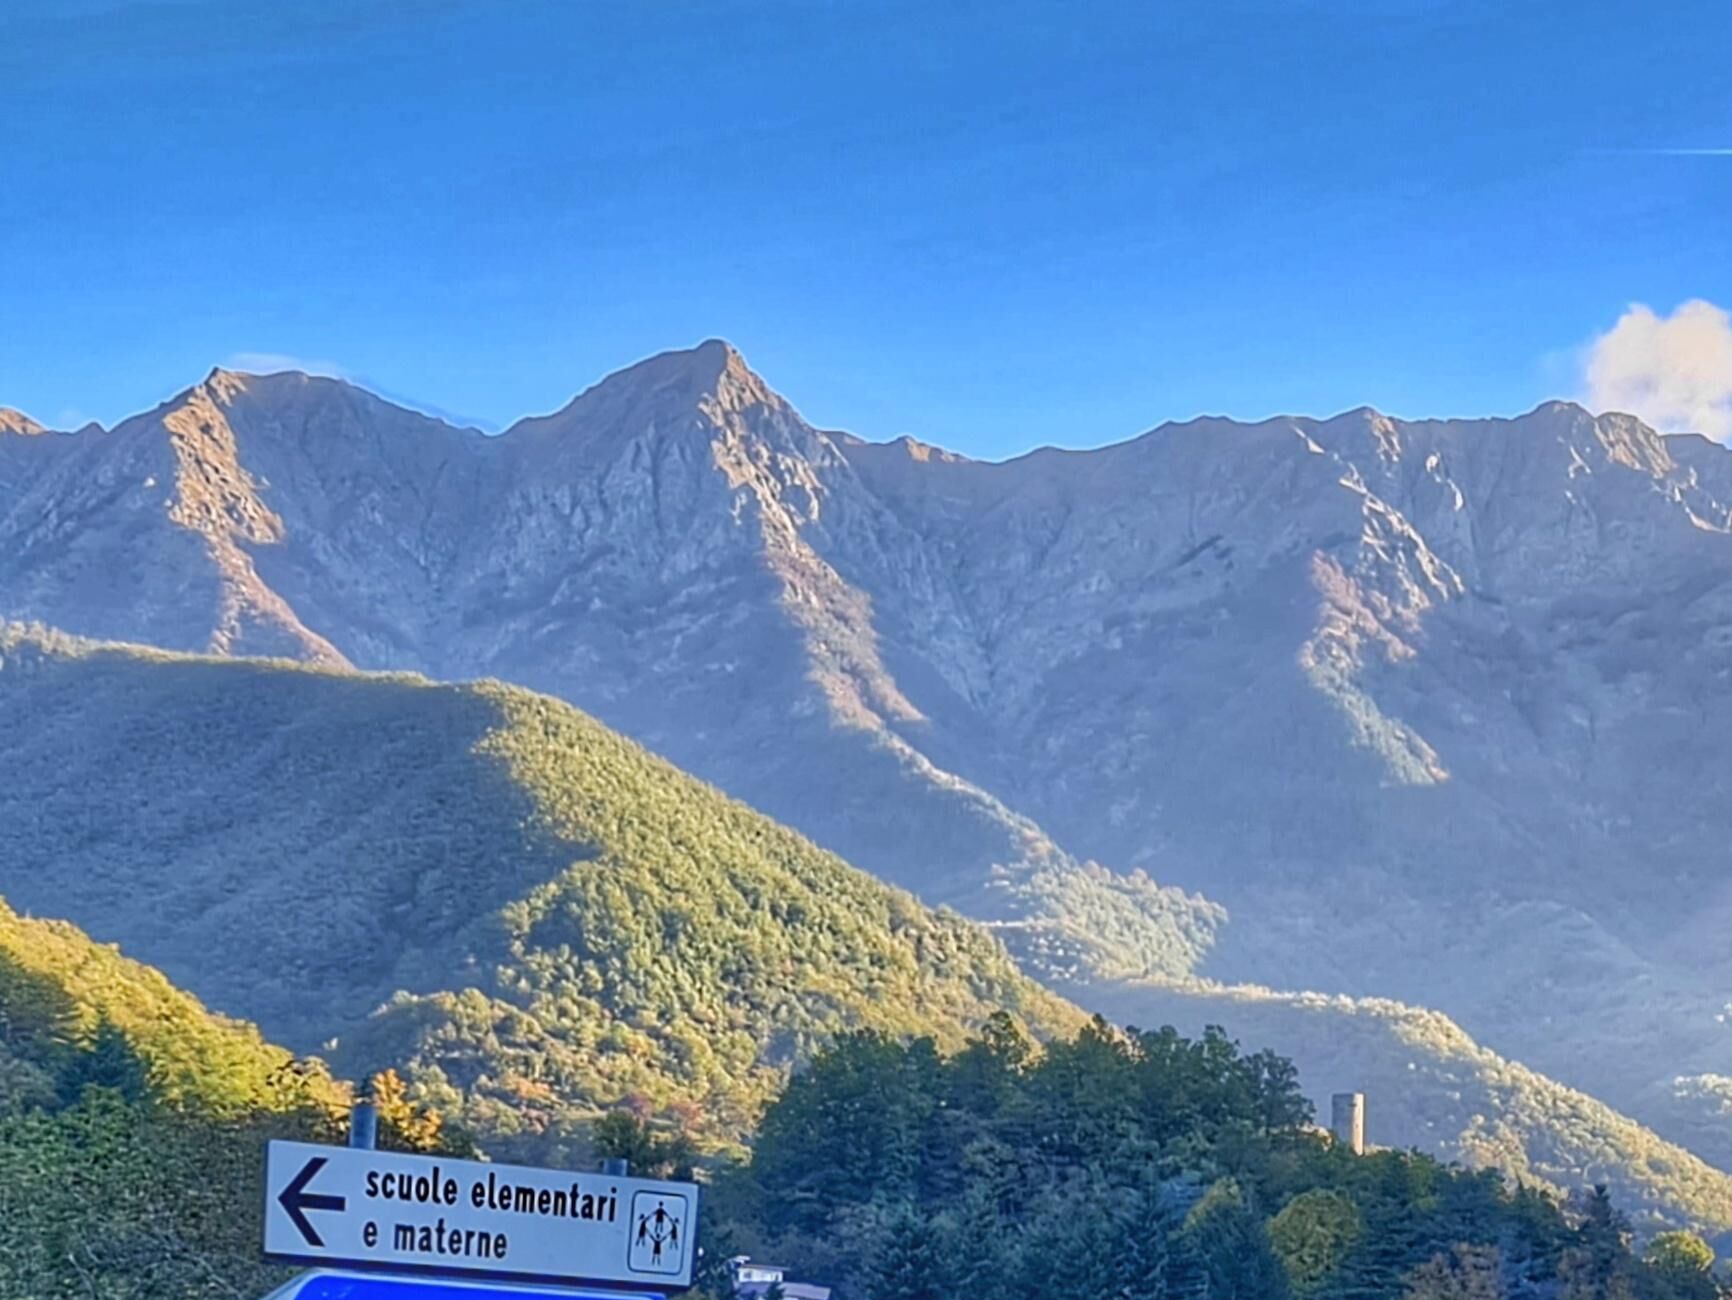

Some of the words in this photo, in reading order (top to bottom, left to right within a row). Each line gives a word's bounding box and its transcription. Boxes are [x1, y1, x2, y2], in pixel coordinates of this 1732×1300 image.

[365, 1166, 458, 1206] scuole
[471, 1172, 618, 1222] elementari
[363, 1221, 378, 1248] e
[394, 1218, 508, 1259] materne
